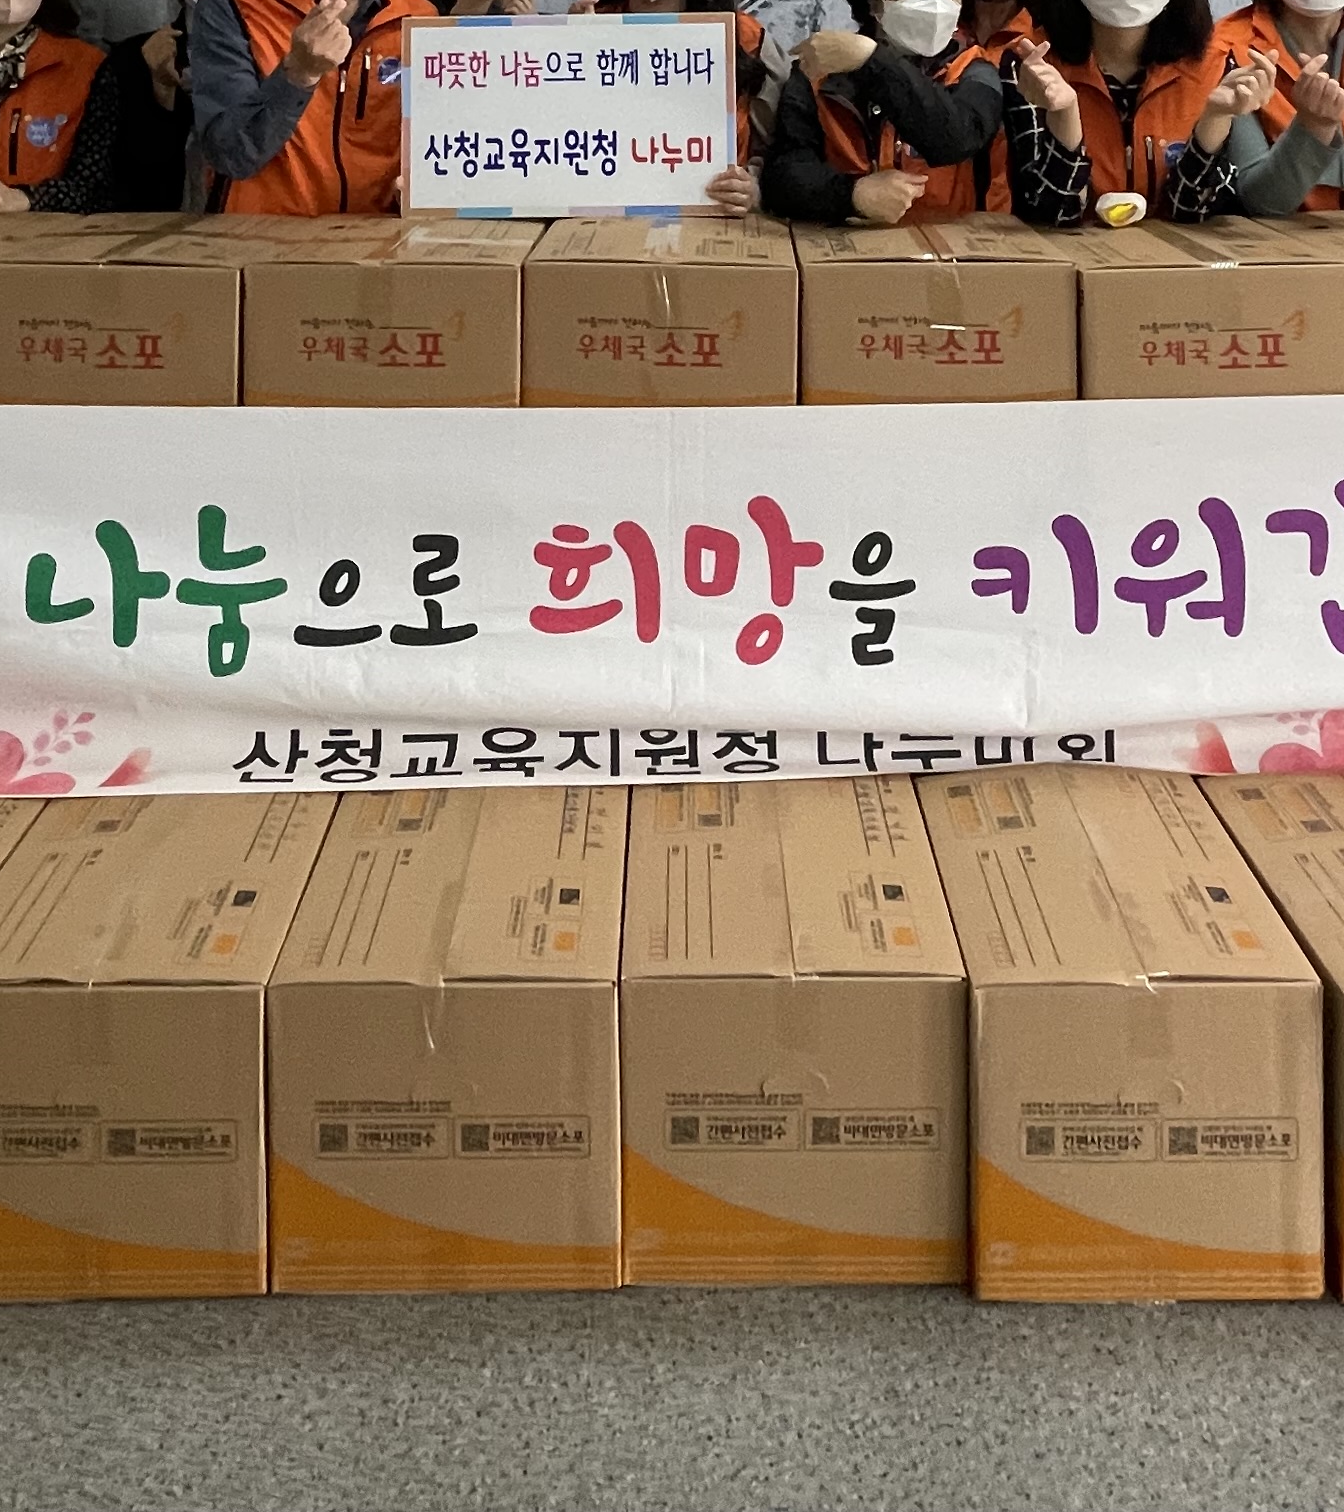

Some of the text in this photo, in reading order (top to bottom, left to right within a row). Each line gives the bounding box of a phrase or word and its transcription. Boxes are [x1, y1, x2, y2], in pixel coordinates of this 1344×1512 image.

[423, 48, 714, 89] 따뜻한 나눔으로 함께 합니다
[424, 128, 713, 178] 산청교육지원청 나누미
[95, 334, 164, 369] 소포
[297, 333, 446, 367] 우체국 소포
[576, 332, 722, 367] 우체국 소포
[857, 330, 1004, 364] 우체국 소포
[1139, 334, 1288, 369] 우체국 소포
[24, 505, 478, 678] 나눔으로
[529, 494, 918, 666] 희망을
